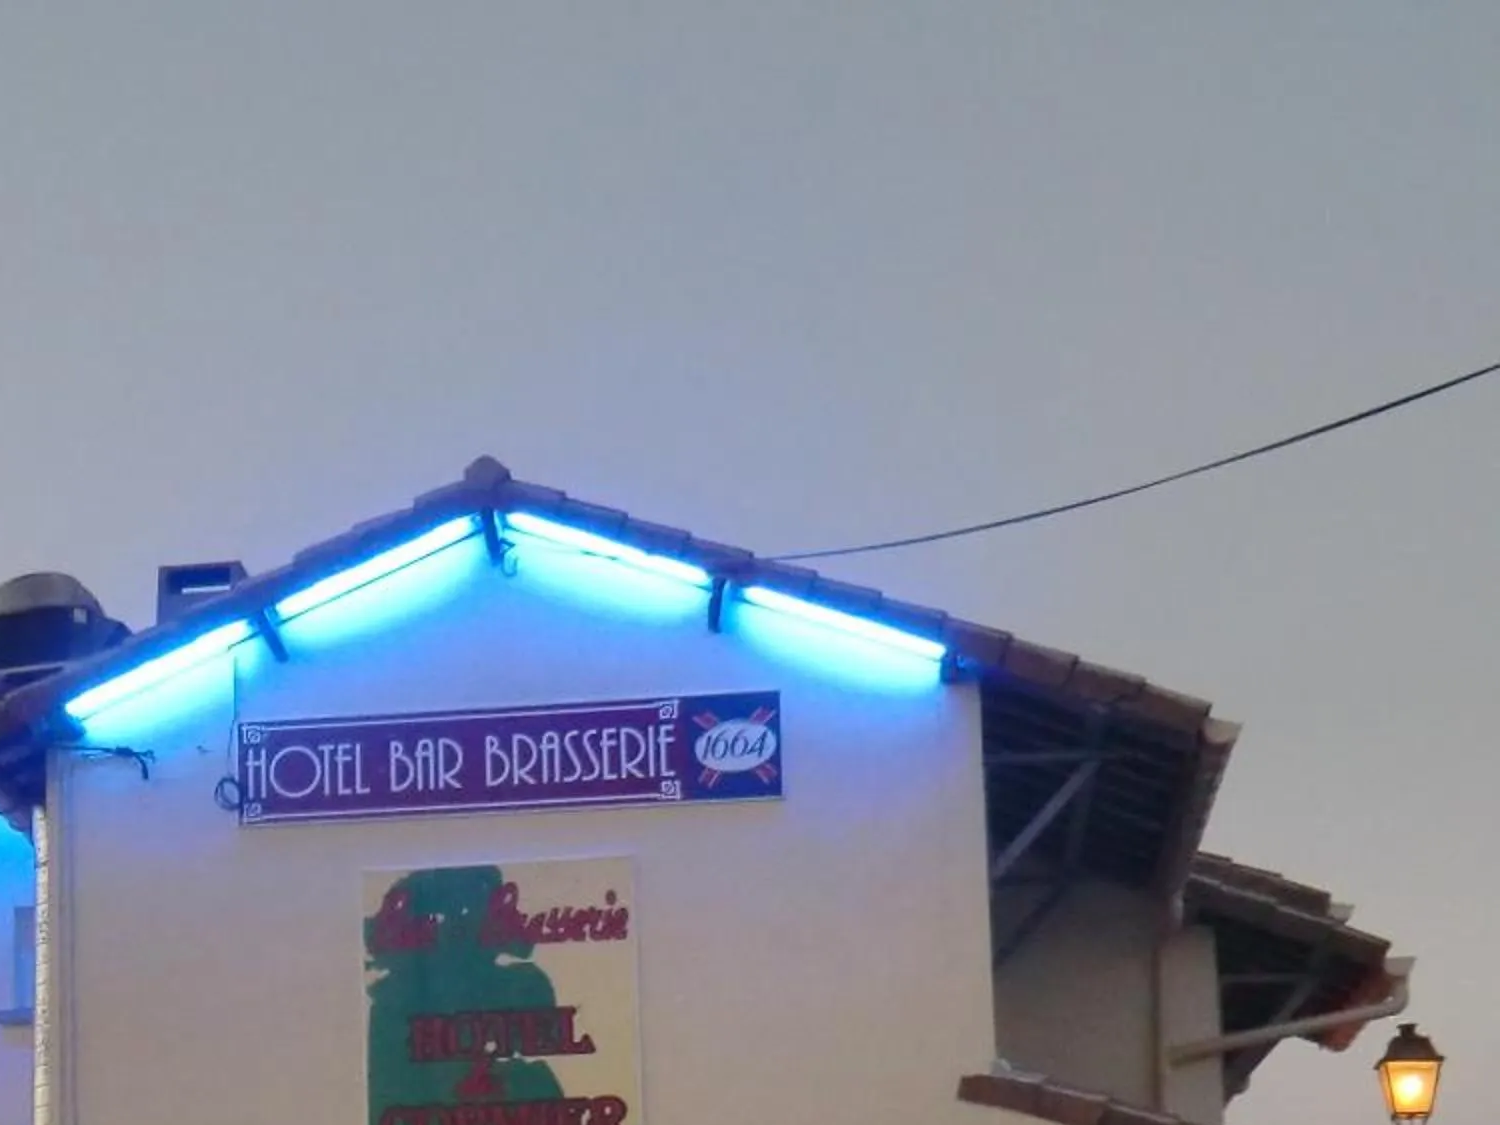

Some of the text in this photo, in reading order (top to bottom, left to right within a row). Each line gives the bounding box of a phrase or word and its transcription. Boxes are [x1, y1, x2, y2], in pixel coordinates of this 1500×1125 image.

[245, 723, 677, 799] HOTEL BAR BRASSERIE
[702, 728, 769, 760] 1664
[408, 1005, 597, 1063] HOTEL
